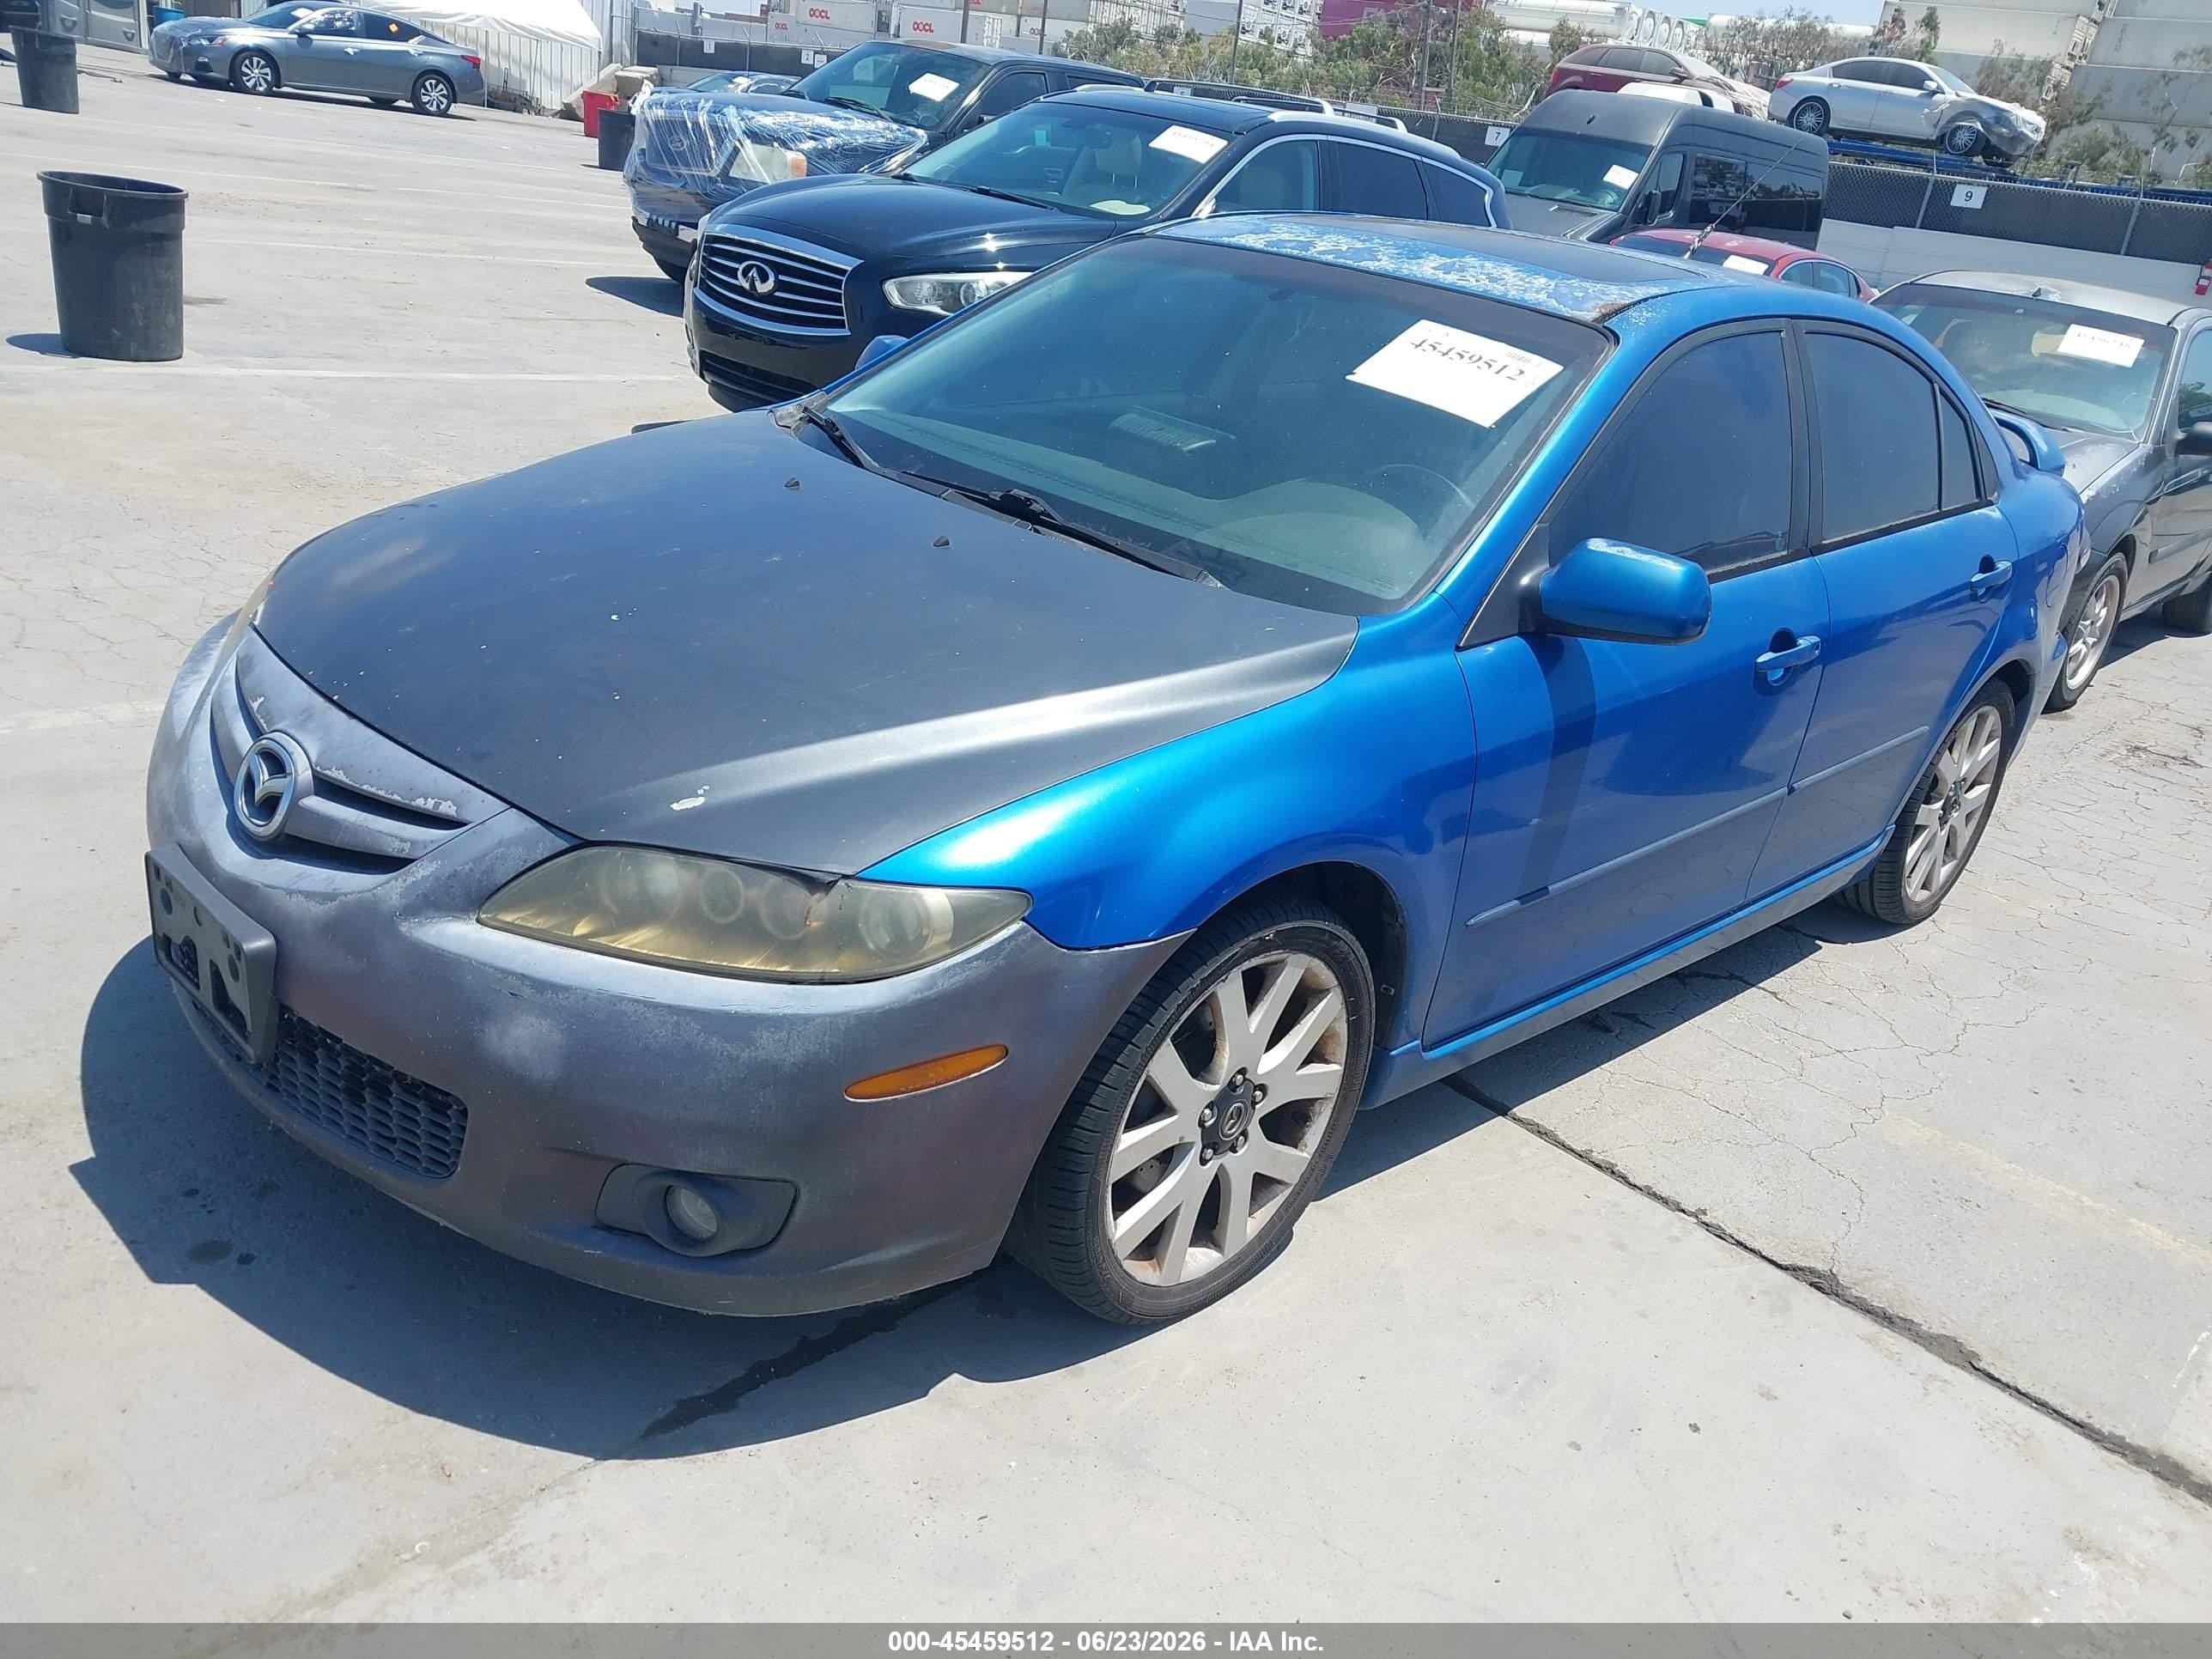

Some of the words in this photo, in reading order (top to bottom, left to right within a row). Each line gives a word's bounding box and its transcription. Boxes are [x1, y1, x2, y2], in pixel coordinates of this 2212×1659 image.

[809, 8, 830, 20] OOCL
[775, 22, 788, 31] OOCL
[912, 21, 934, 33] OOCL
[1495, 131, 1501, 142] 7
[1964, 191, 1973, 202] 9
[1410, 338, 1525, 381] 45459512
